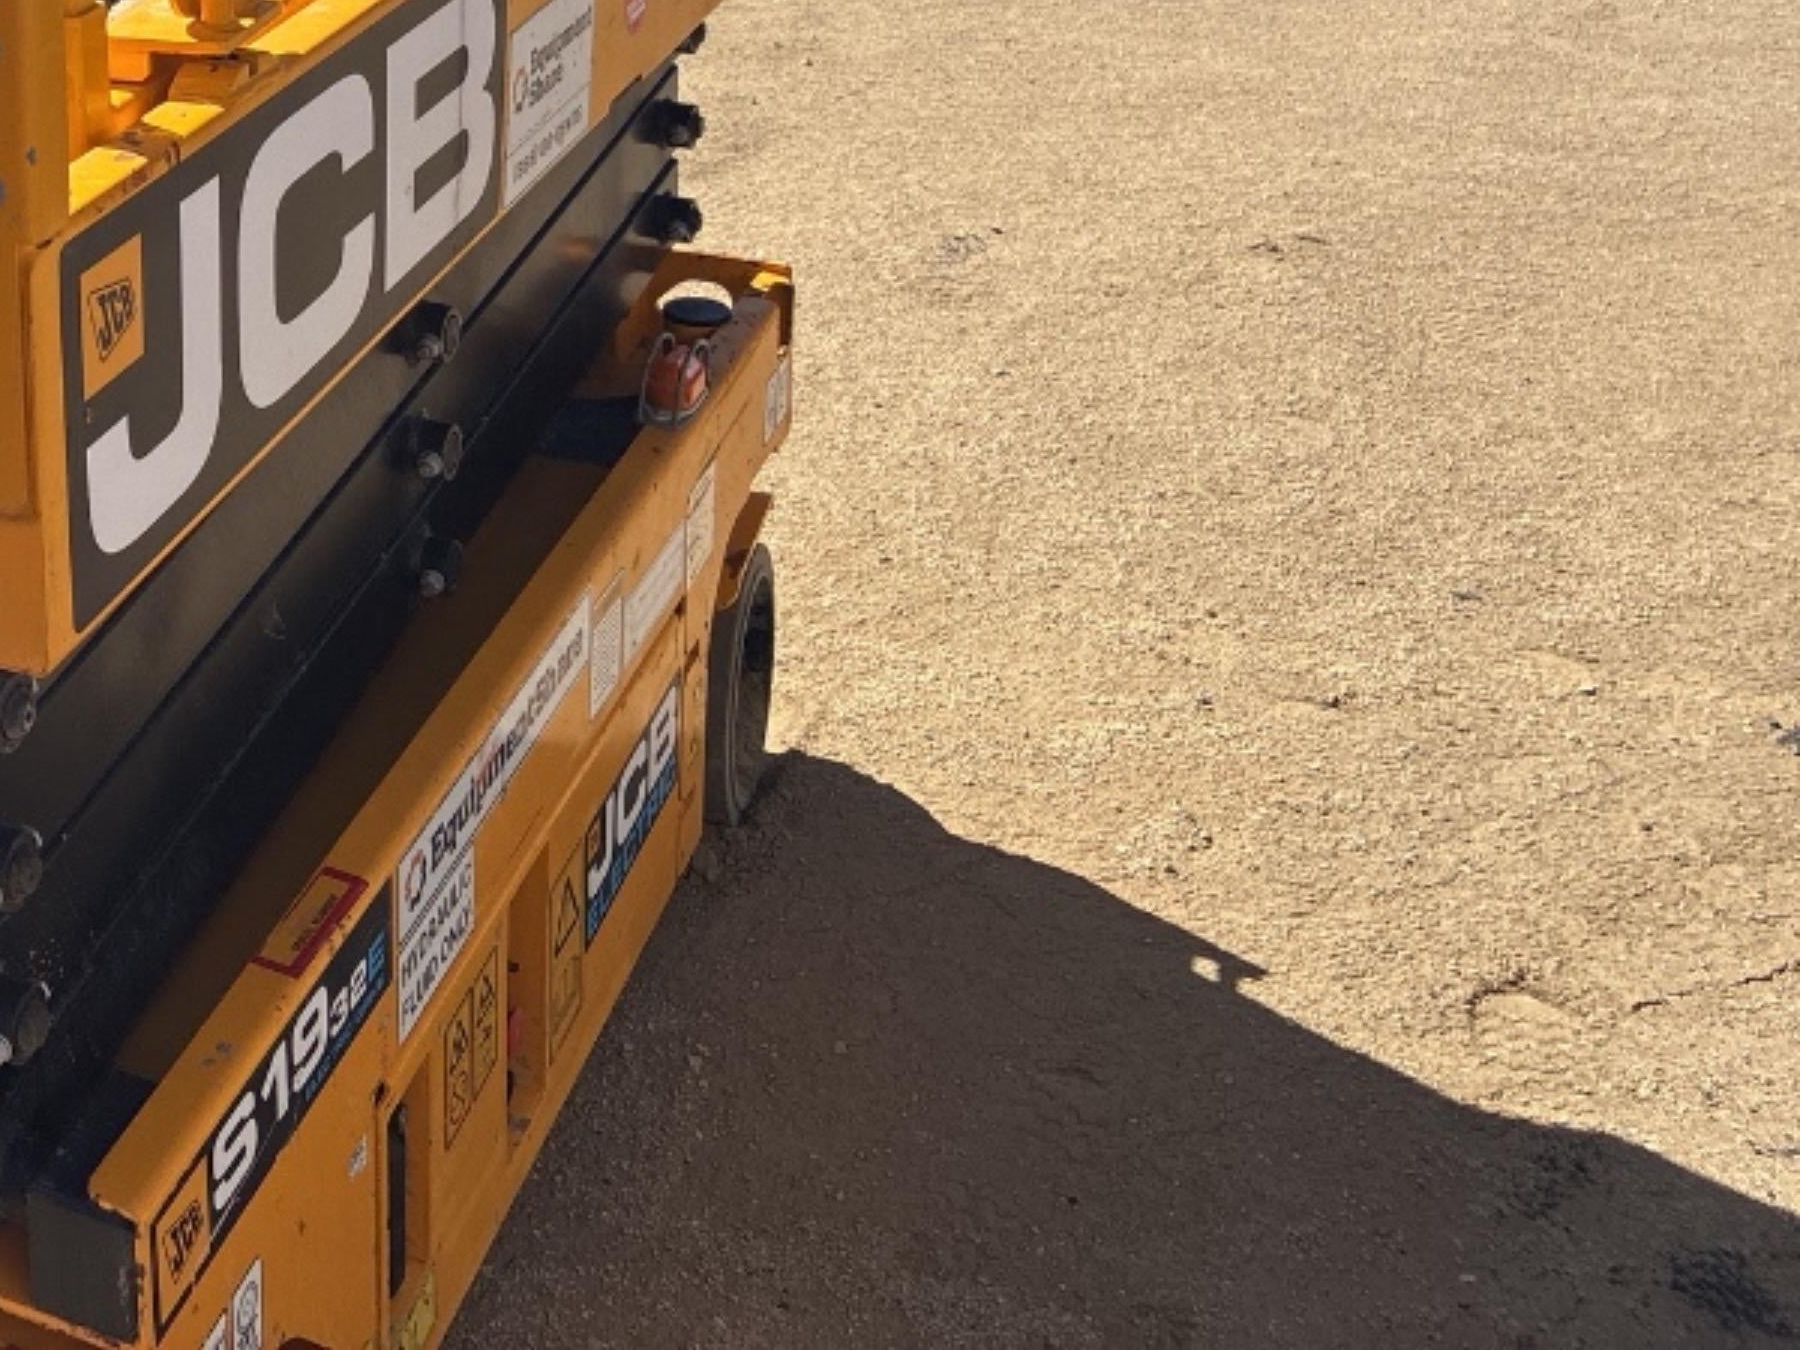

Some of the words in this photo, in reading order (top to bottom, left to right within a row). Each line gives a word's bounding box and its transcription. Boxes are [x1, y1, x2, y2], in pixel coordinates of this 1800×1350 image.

[96, 283, 134, 352] JCB
[587, 686, 677, 900] JCB
[401, 861, 473, 989] HYDRAULIC
[401, 953, 439, 1027] FLUID
[170, 1202, 201, 1273] JCB
